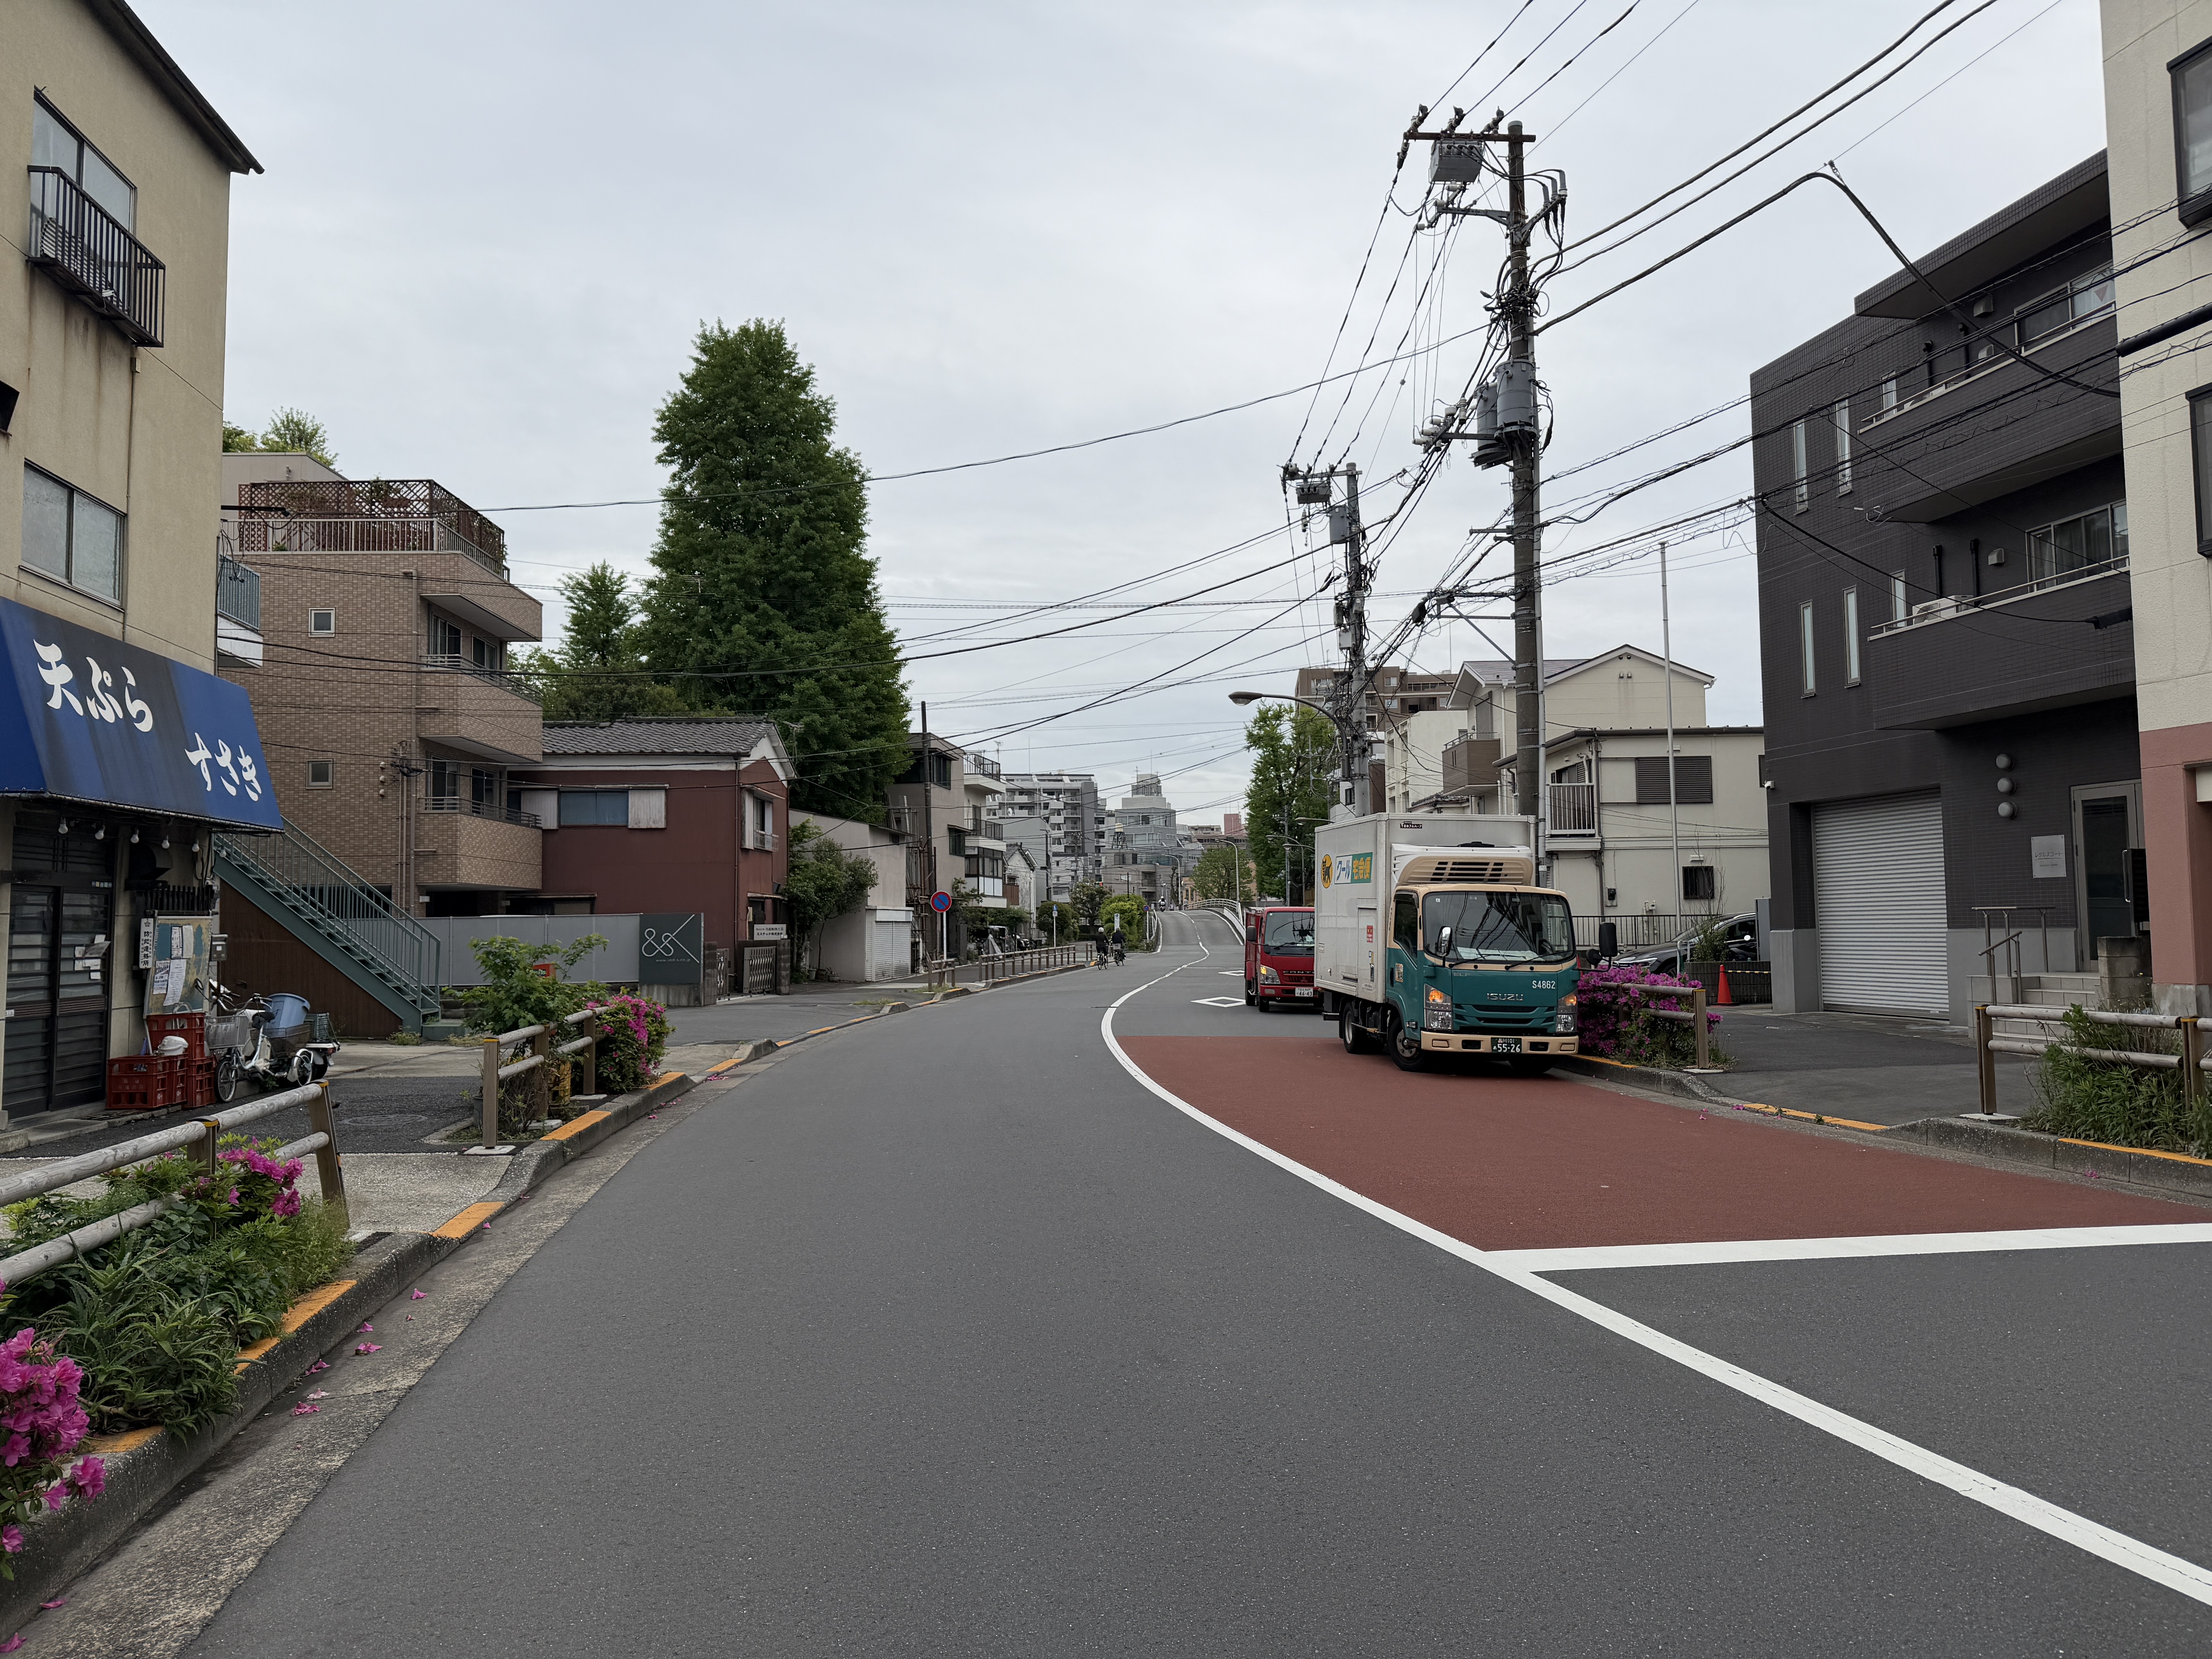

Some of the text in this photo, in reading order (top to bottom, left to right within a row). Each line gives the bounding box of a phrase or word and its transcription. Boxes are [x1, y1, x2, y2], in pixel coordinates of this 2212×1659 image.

[33, 639, 153, 732] 天ぷら
[184, 732, 262, 802] すさき
[1532, 980, 1556, 989] S4862
[1487, 993, 1524, 1001] ISUZU
[1498, 1043, 1520, 1053] 55-26
